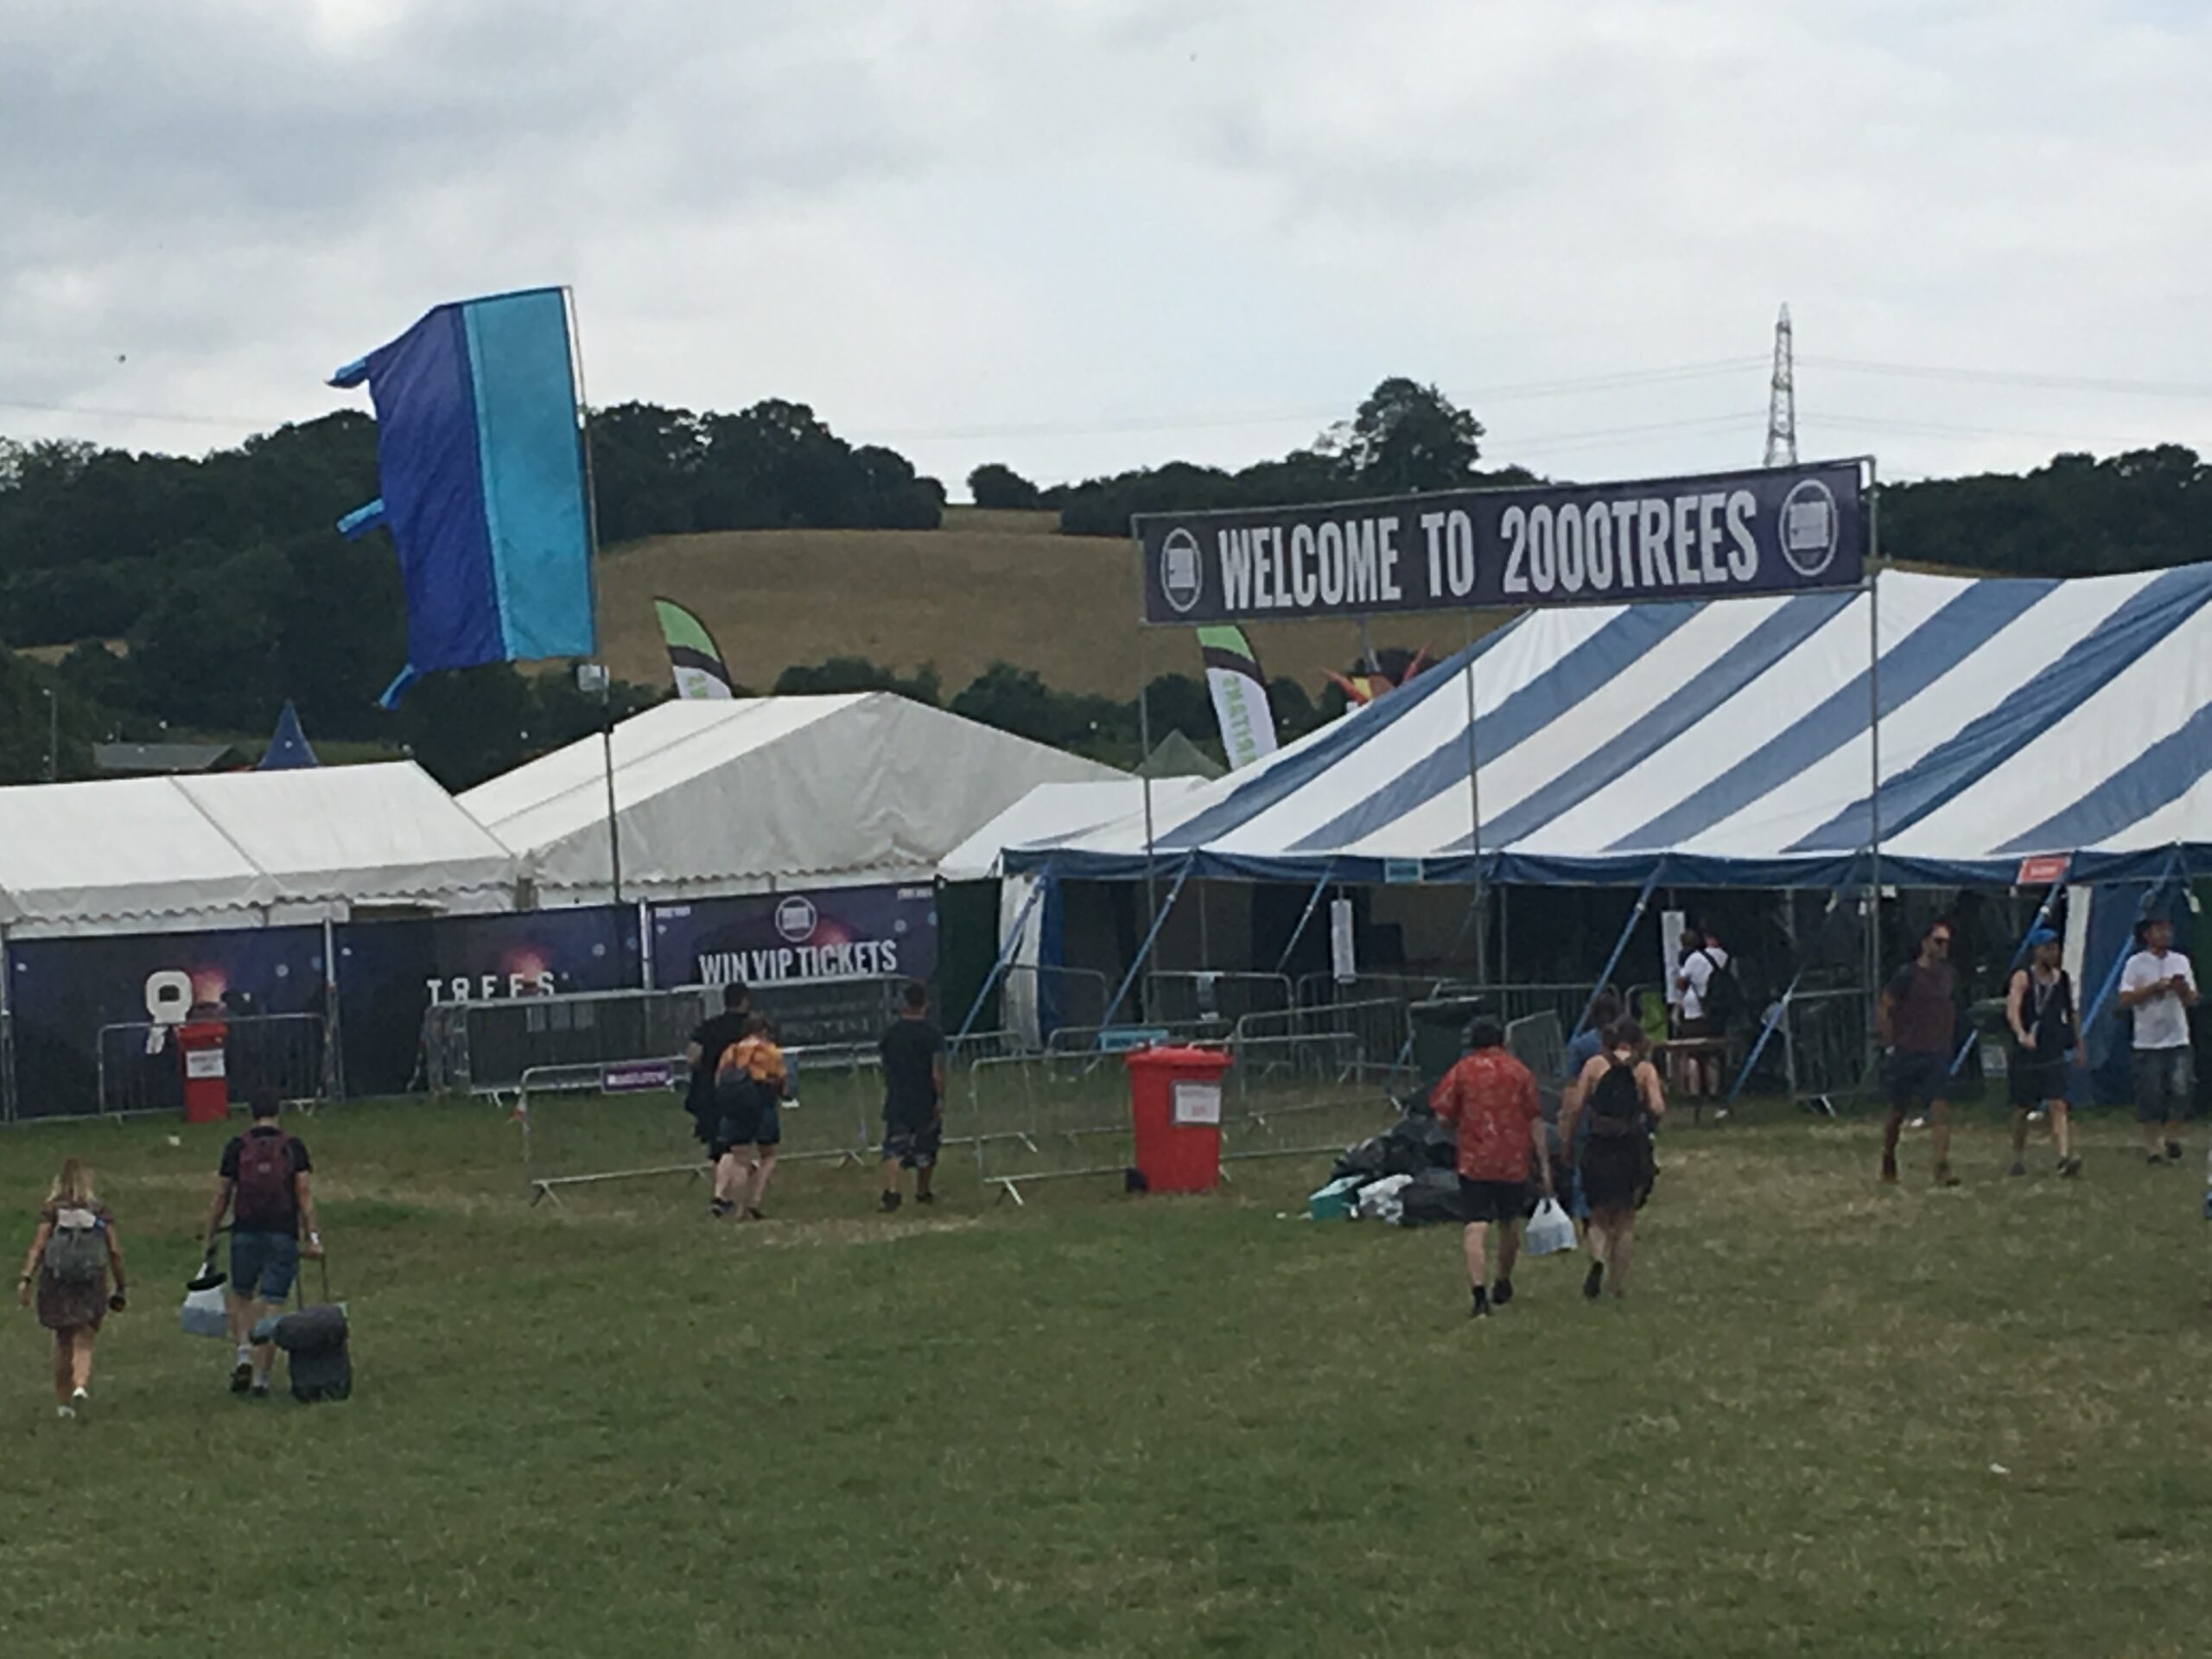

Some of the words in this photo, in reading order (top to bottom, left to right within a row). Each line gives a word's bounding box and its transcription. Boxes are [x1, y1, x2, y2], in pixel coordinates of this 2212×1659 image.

[1217, 518, 1402, 611] WELCOME
[1421, 510, 1474, 598] TO
[1501, 489, 1759, 594] 2000TREES
[698, 951, 749, 984] WIN
[752, 948, 792, 981] VIP
[795, 939, 898, 977] TICKETS
